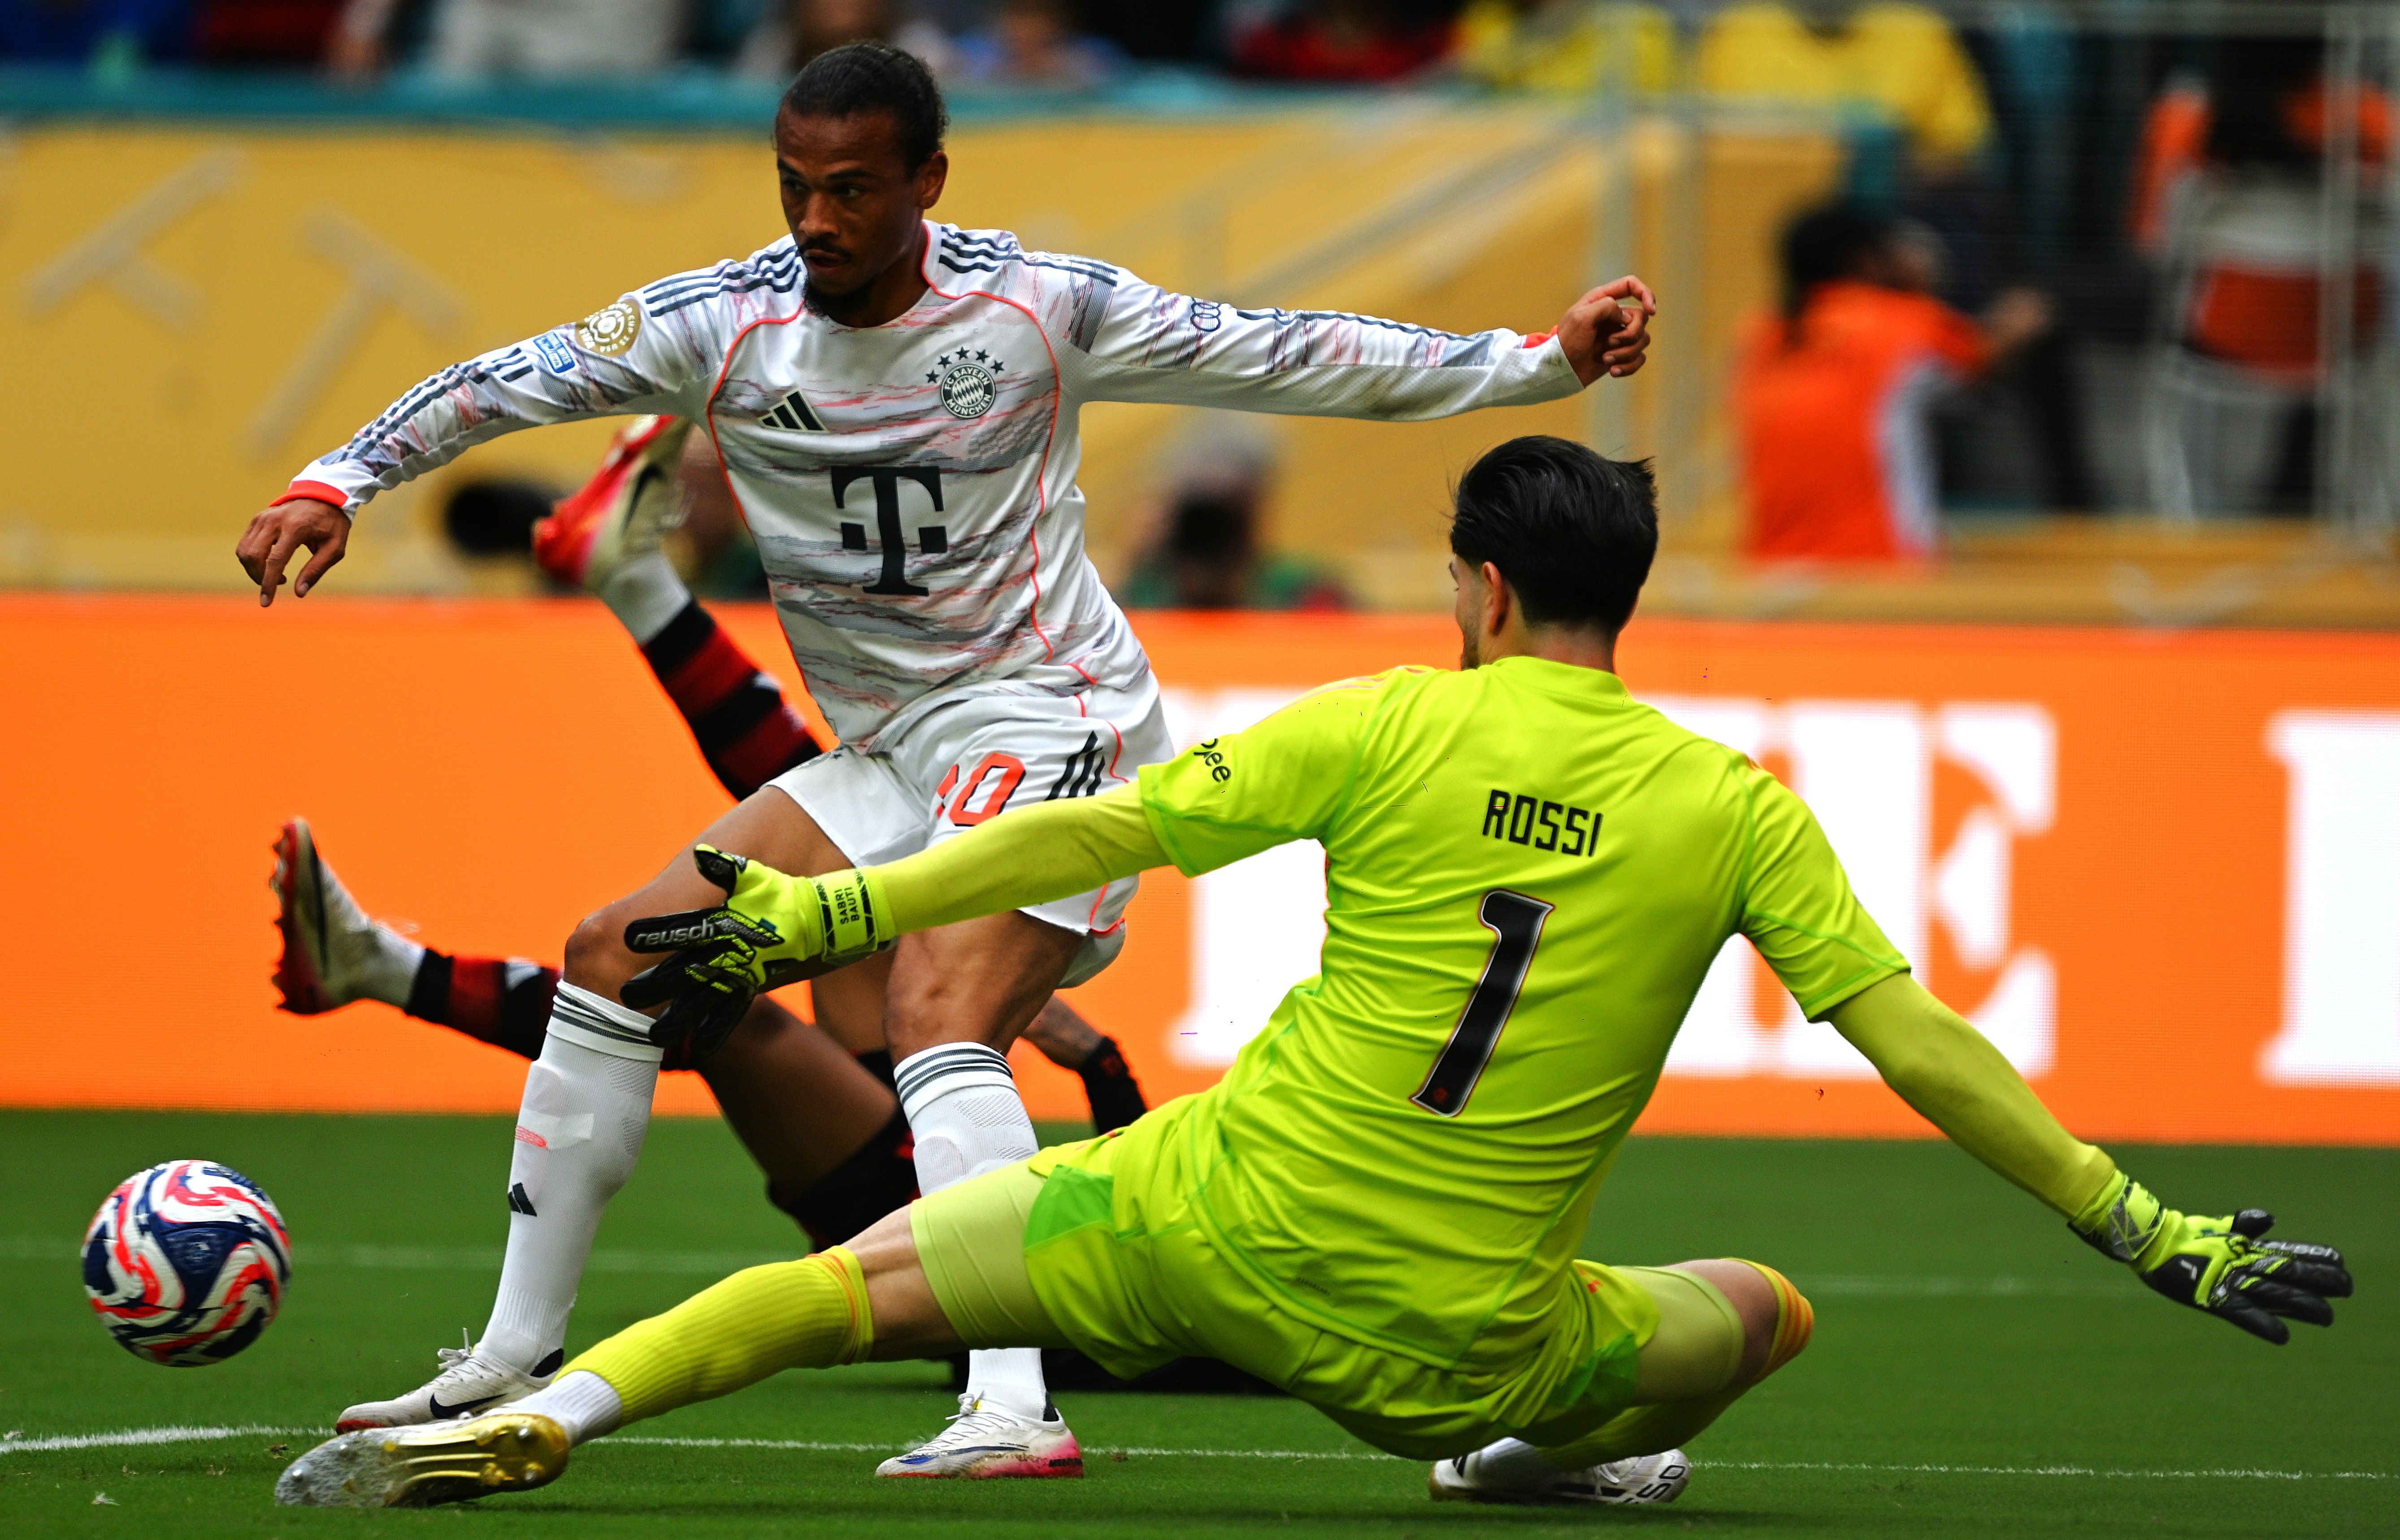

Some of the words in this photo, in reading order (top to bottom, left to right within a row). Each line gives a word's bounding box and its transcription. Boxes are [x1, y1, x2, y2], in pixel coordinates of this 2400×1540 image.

[945, 378, 955, 390] FC
[955, 367, 990, 385] BAYERN
[830, 465, 943, 597] T
[1483, 790, 1604, 857] ROSSI
[834, 889, 849, 924] SABRI
[844, 887, 860, 922] BAUTI
[633, 919, 715, 946] reusch
[1409, 888, 1556, 1117] 1
